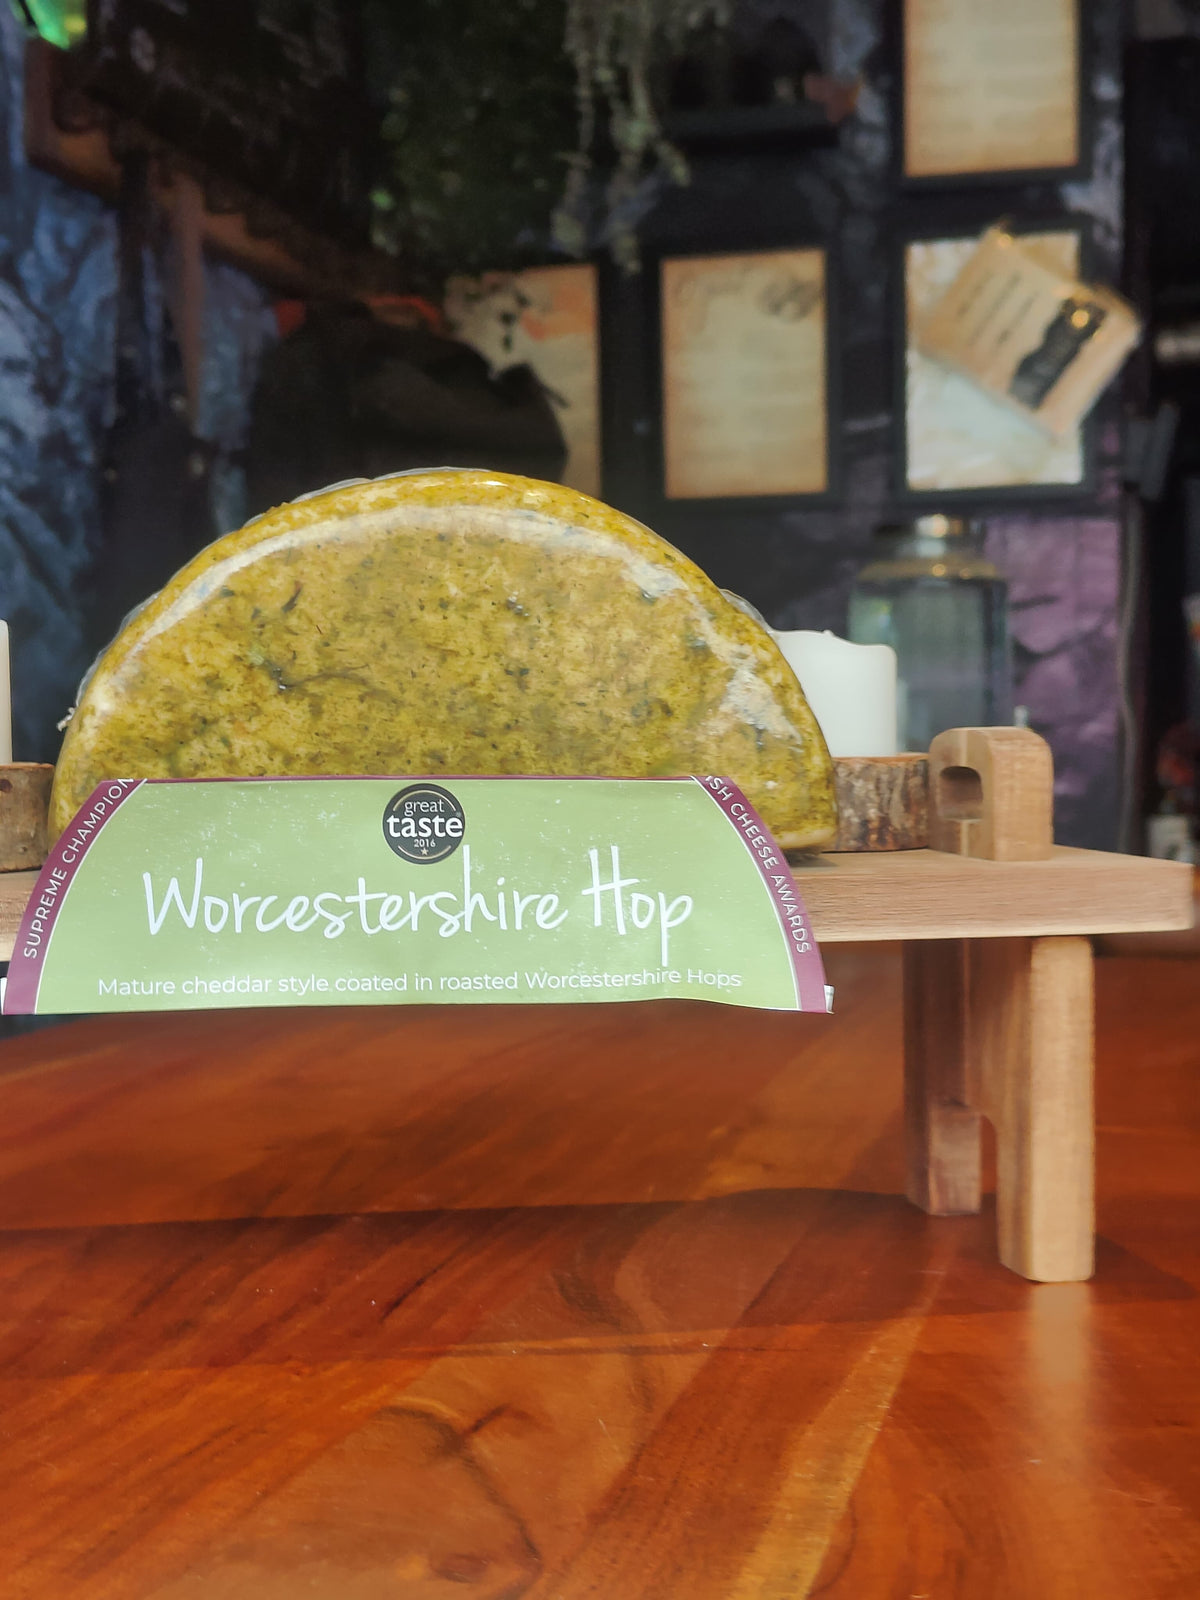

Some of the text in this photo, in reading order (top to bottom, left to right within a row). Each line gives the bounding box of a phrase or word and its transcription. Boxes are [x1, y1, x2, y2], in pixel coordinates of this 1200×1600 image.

[404, 799, 445, 817] great
[386, 815, 463, 838] taste
[413, 838, 436, 848] 2016
[730, 803, 780, 870] CHEESE
[771, 875, 812, 953] AWARDS
[24, 866, 67, 959] SUPREME
[142, 845, 693, 967] Worcestershire Hop
[98, 967, 744, 996] Mature cheddar style coated in roasted Worcestershire Hops
